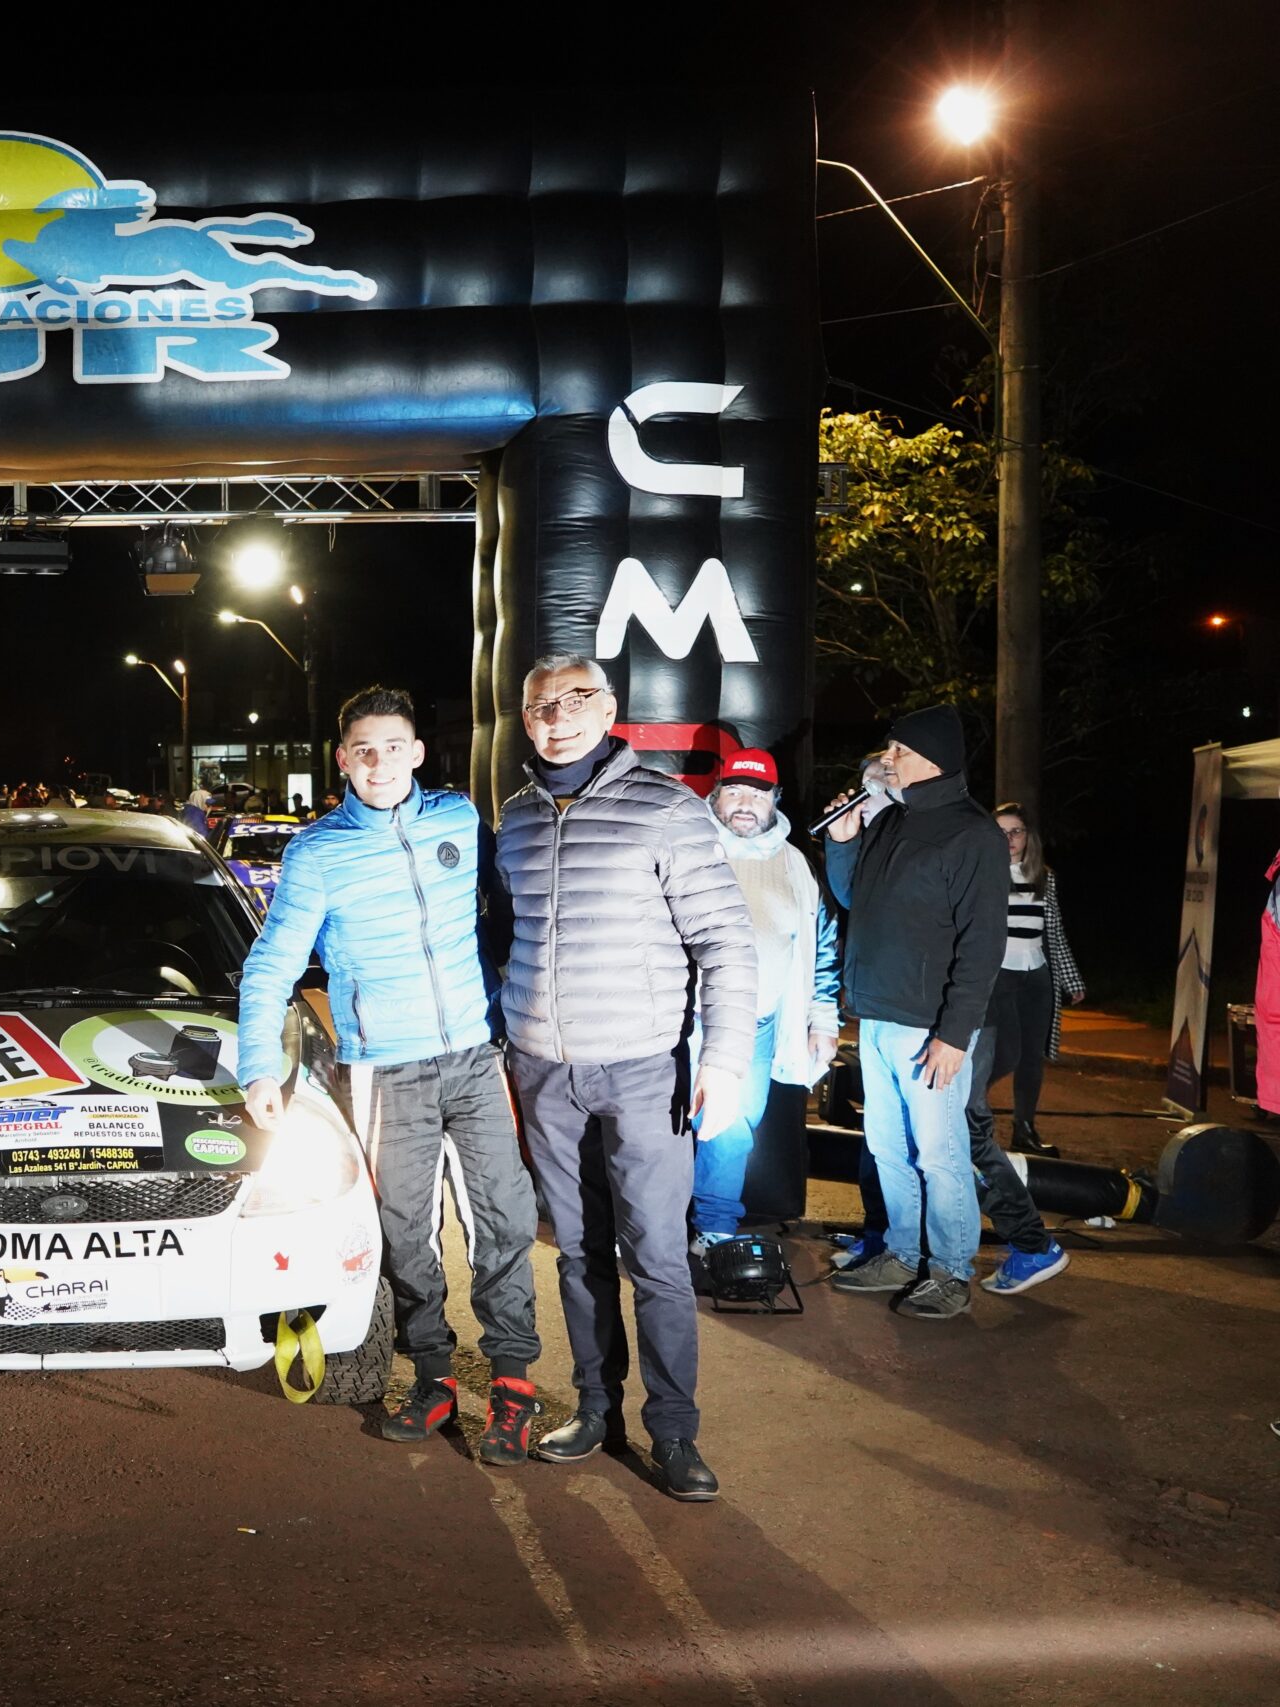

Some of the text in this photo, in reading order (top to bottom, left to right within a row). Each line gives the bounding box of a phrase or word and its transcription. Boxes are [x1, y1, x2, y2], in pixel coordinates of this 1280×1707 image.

[732, 760, 767, 773] MOTUL
[80, 1105, 149, 1113] ALINEACION
[88, 1122, 144, 1130] BALANCEO
[11, 1150, 40, 1162] 03743
[47, 1148, 81, 1160] 493248
[90, 1148, 134, 1159] 15488366
[193, 1143, 239, 1155] CAPIOVI
[9, 1165, 23, 1173] Las
[24, 1164, 53, 1172] Azaleas
[54, 1162, 67, 1171] 541
[83, 1229, 184, 1259] ALTA
[26, 1280, 108, 1298] CHARAI
